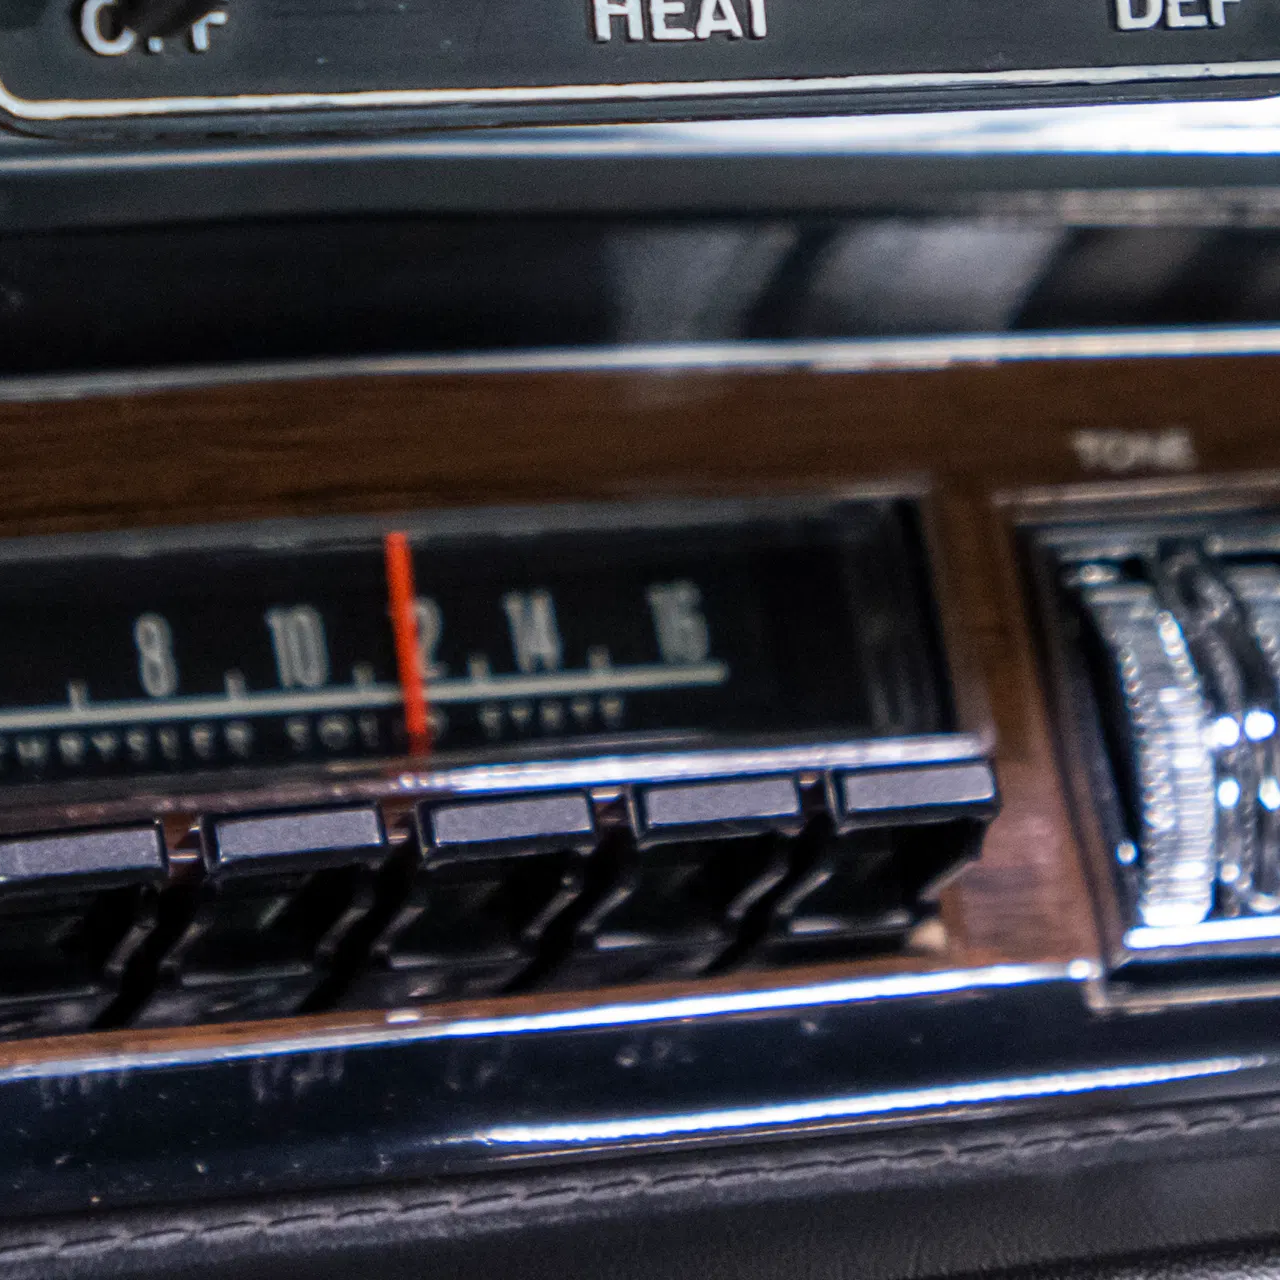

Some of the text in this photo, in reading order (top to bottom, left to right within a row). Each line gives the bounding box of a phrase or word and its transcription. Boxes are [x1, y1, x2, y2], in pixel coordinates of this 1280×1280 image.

[134, 613, 179, 699] 8
[266, 603, 330, 690] 10
[503, 588, 562, 671] 14
[645, 580, 711, 665] 16
